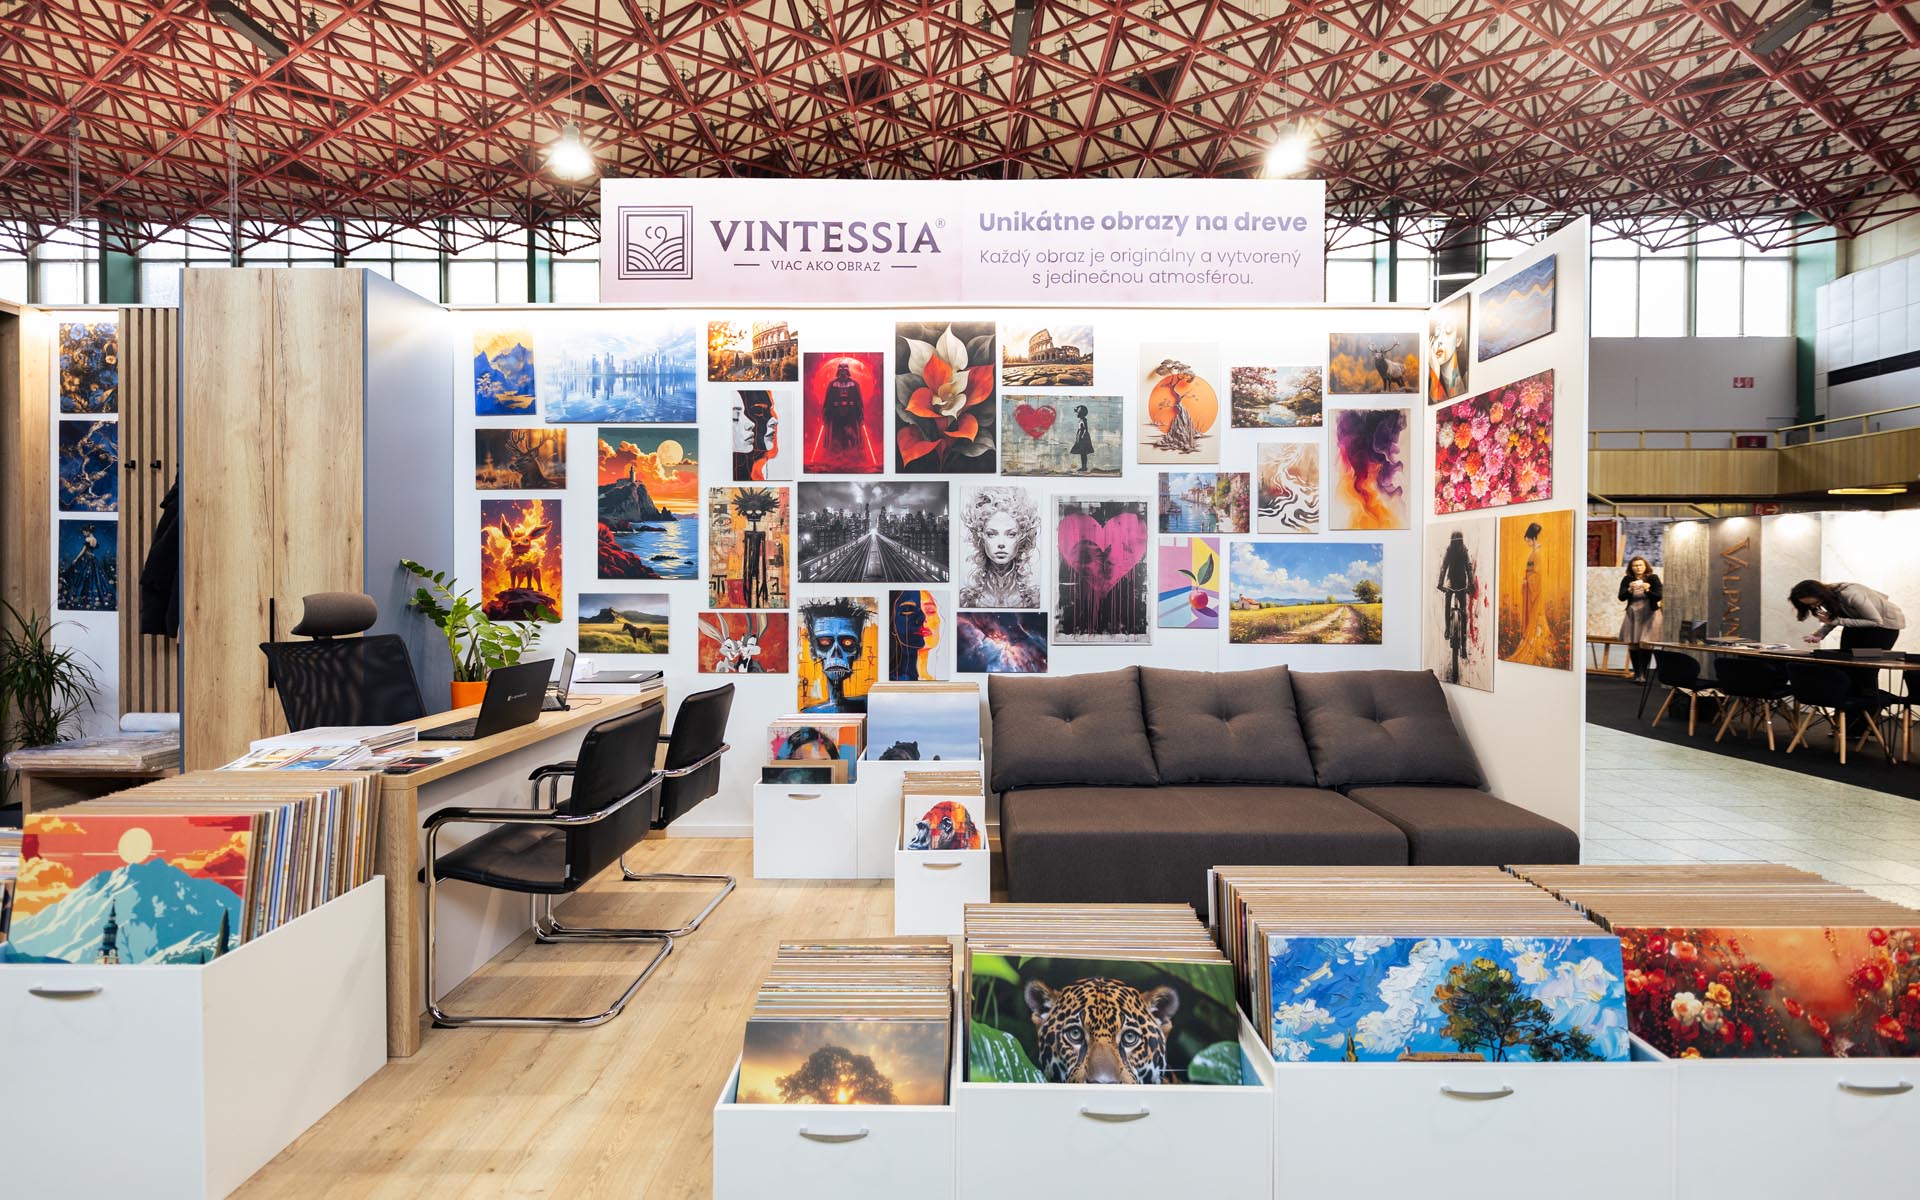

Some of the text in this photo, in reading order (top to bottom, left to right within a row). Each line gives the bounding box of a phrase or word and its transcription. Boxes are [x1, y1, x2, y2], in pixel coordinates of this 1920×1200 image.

[980, 210, 1307, 236] Unikátne obrazy na dreve
[771, 260, 881, 272] VIAC AKO OBRAZ
[980, 248, 1301, 268] Každý obraz je originálny a vytvorený
[1032, 269, 1254, 288] s jedinečnou atmosférou.
